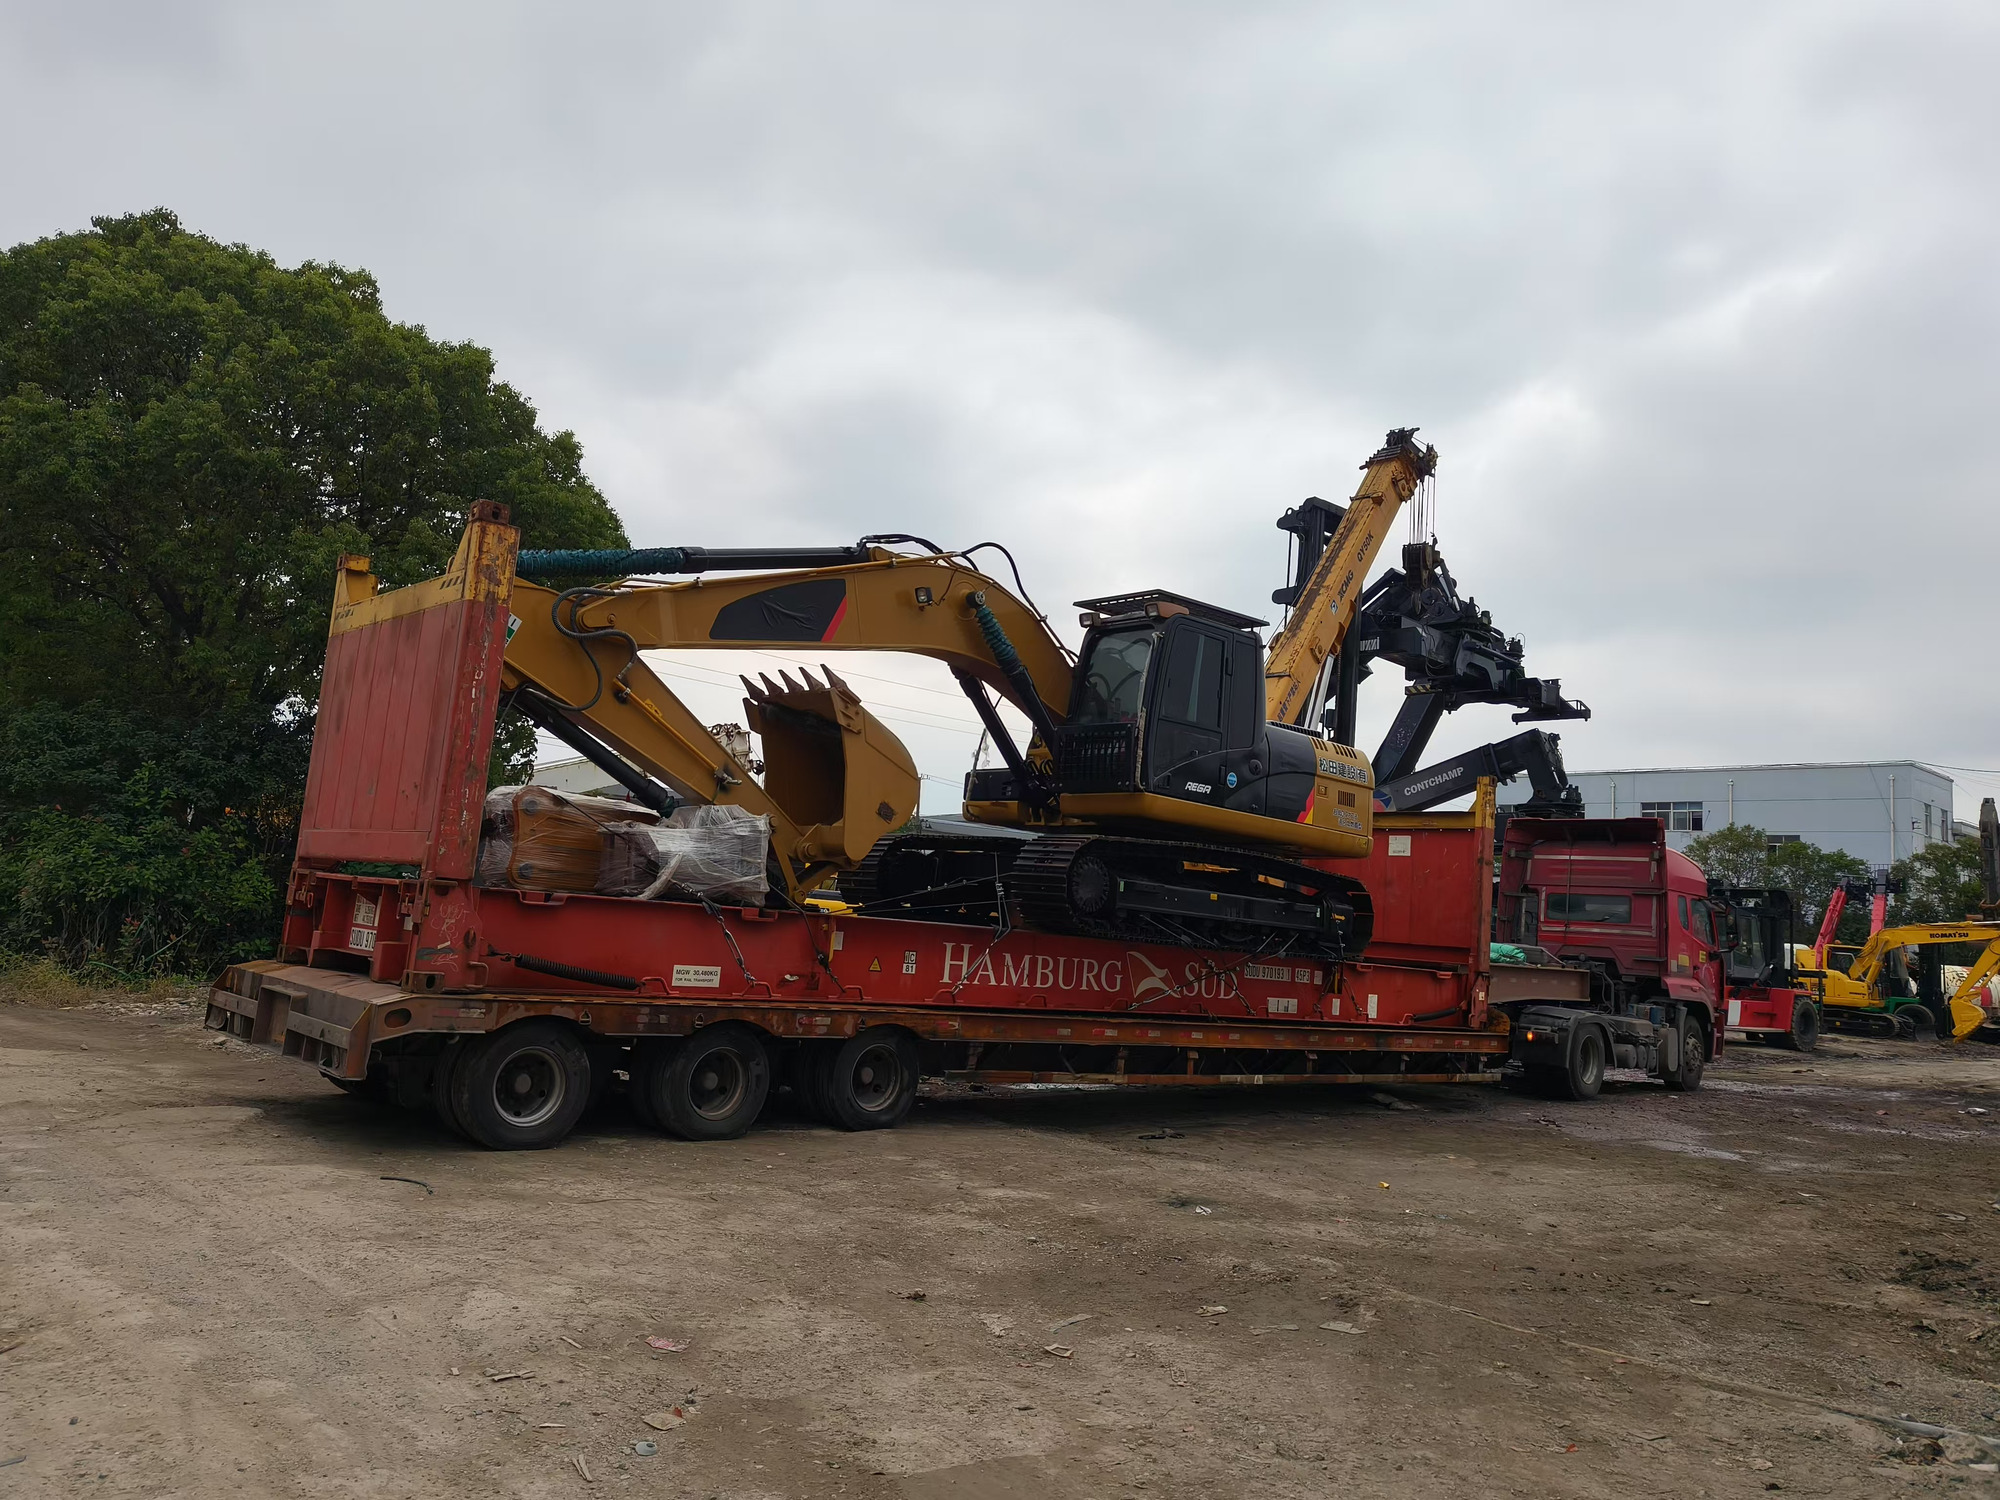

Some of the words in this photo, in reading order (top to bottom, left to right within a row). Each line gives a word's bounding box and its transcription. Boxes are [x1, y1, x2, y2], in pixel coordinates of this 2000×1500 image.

[1357, 530, 1374, 562] QY50K
[1404, 766, 1464, 796] CONTCHAMP
[905, 965, 914, 973] 81
[939, 942, 1124, 992] HAMBURG
[1262, 966, 1285, 980] 970193
[1296, 969, 1310, 983] 45P3
